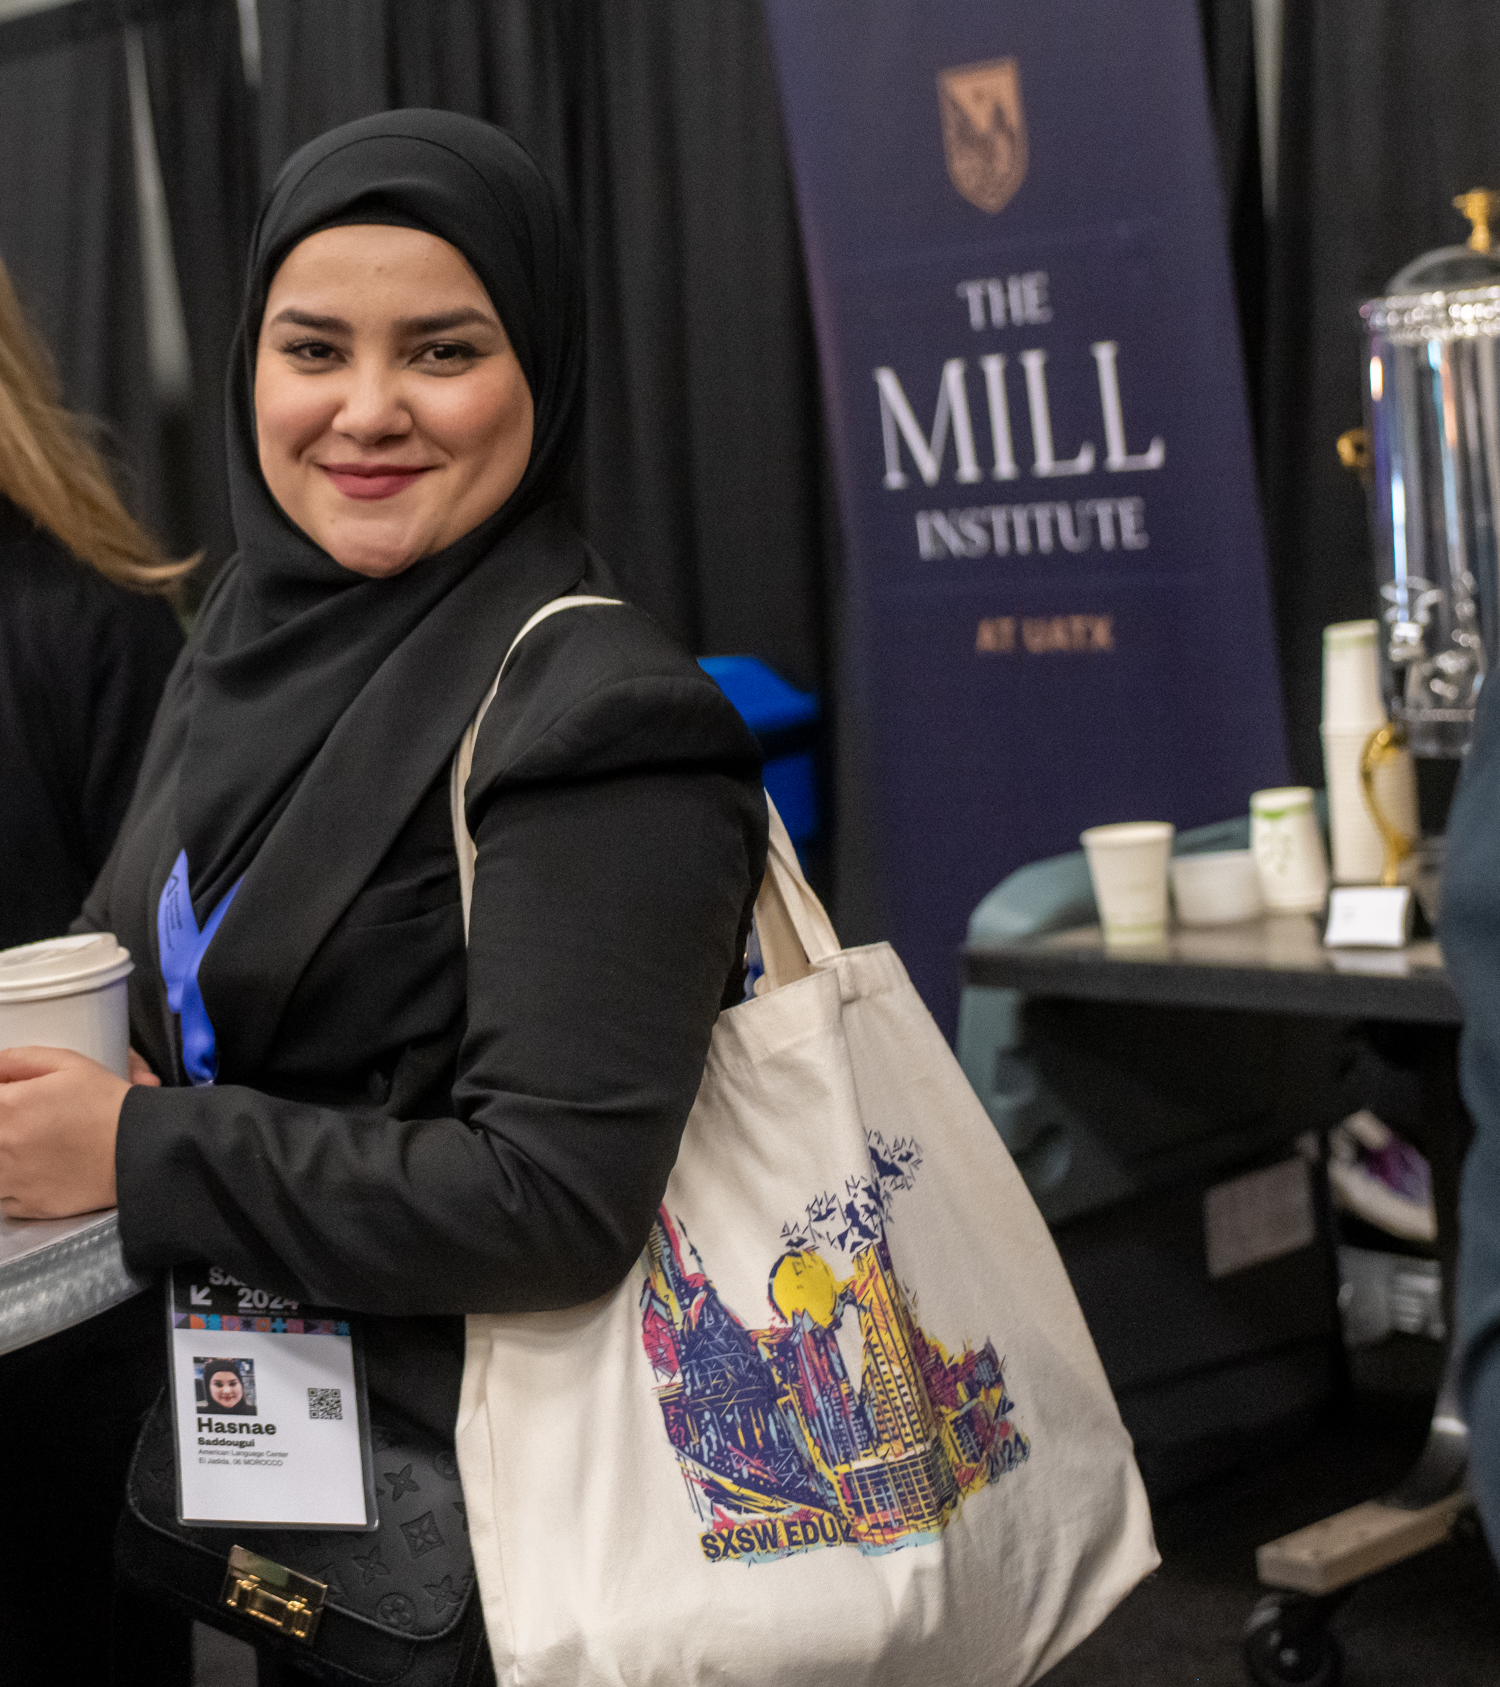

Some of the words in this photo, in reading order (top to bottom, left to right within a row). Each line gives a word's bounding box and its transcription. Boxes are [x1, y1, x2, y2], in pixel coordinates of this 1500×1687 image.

[956, 271, 1054, 332] THE
[874, 340, 1165, 489] MILL
[915, 496, 1149, 561] INSTITUTE
[197, 1416, 277, 1435] Hasnae
[198, 1436, 255, 1448] Saddougui
[266, 1450, 288, 1458] Center
[243, 1459, 284, 1467] MOROCCO
[700, 1521, 779, 1559] SXSW
